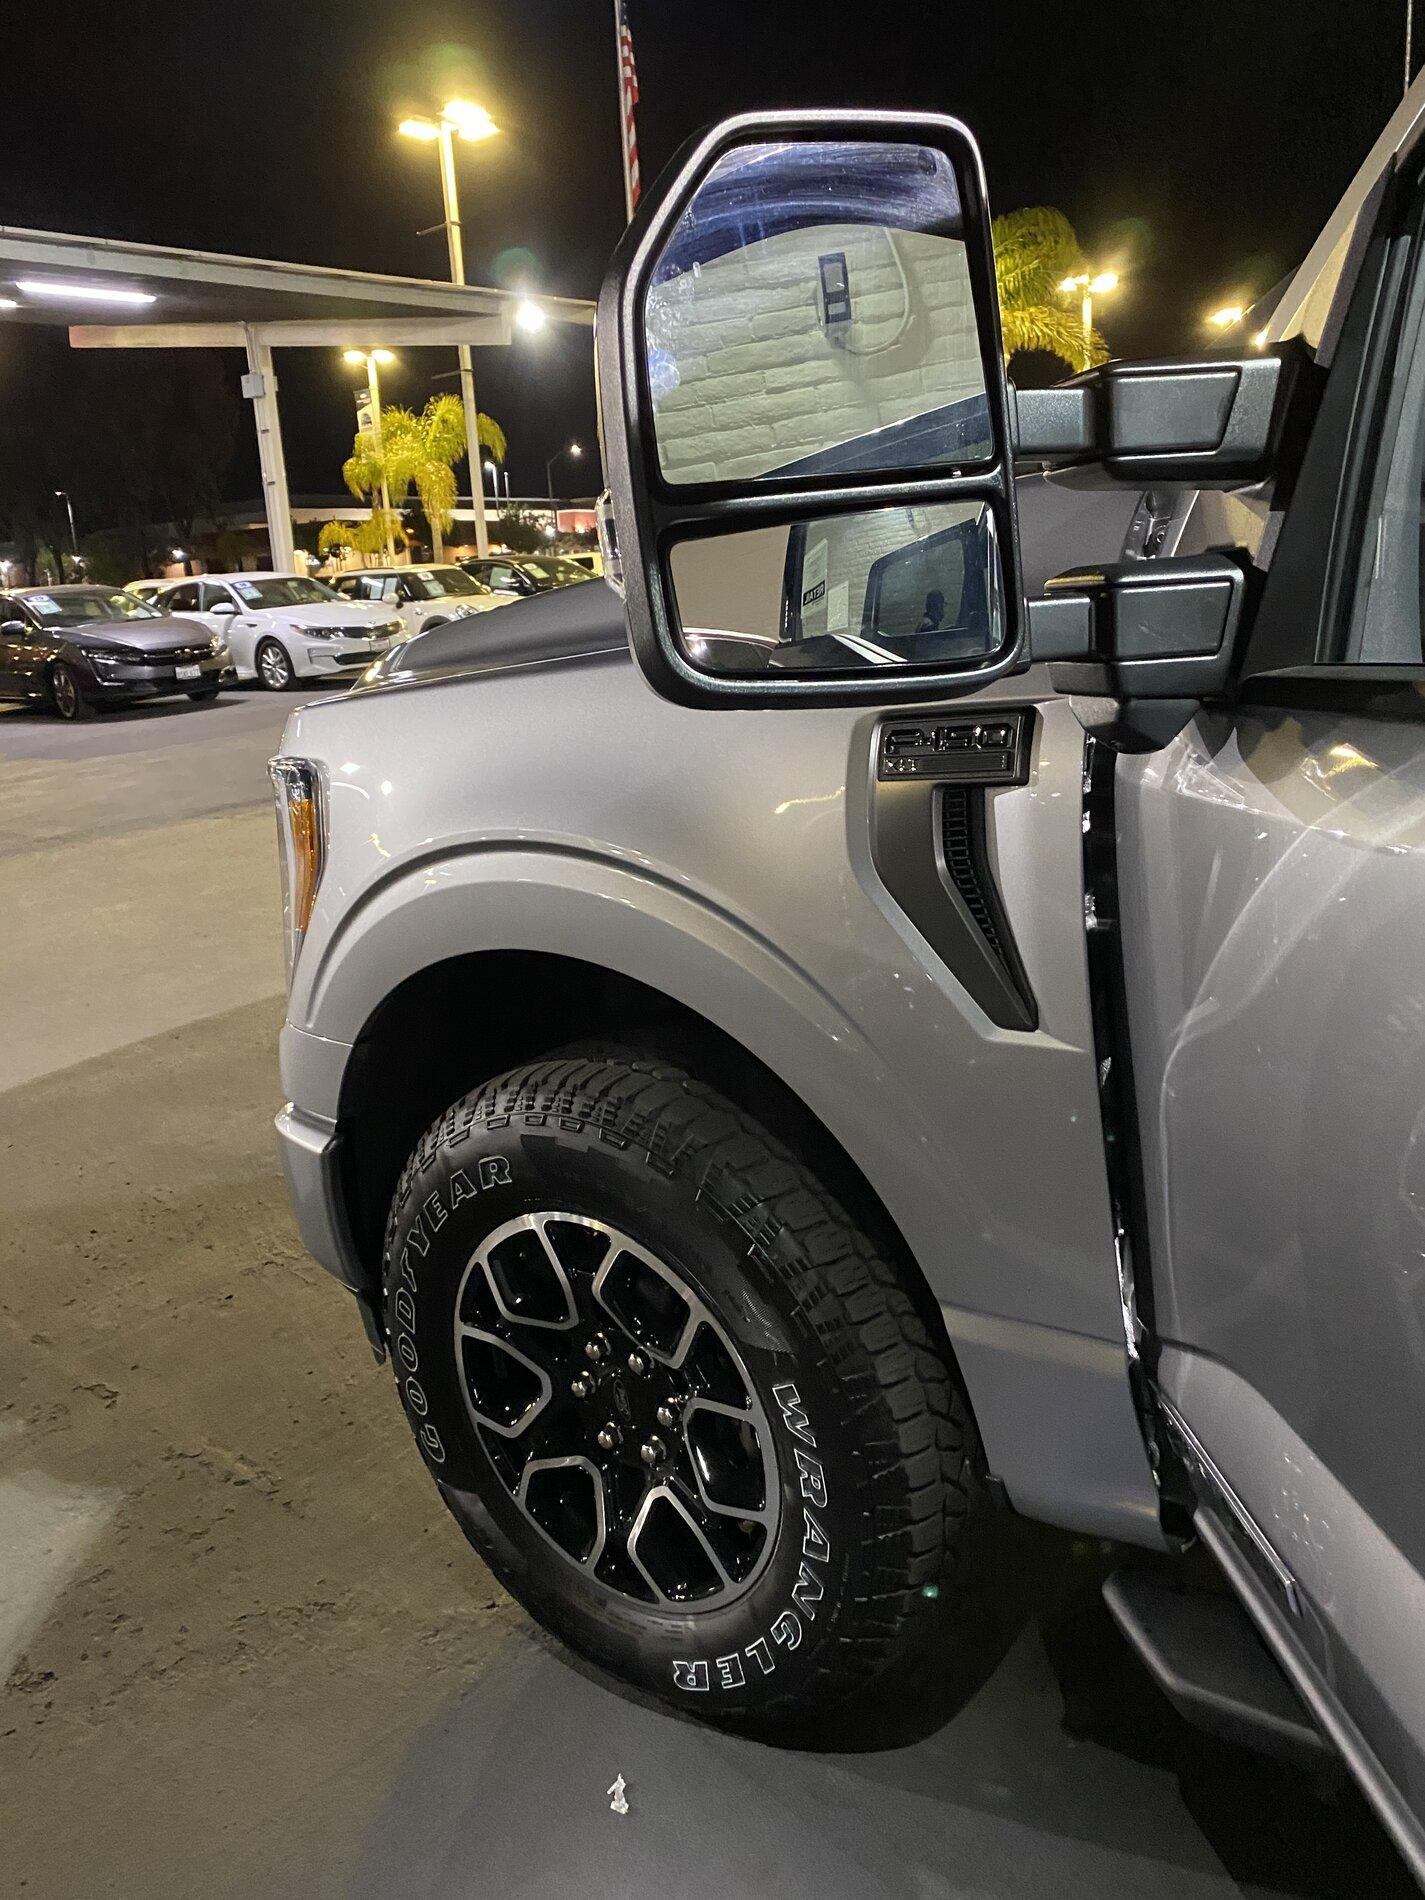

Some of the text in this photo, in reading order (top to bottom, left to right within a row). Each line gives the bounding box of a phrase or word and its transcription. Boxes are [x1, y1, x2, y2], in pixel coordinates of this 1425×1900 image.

[883, 723, 1015, 754] F-150
[395, 1155, 513, 1464] GOODYEAR
[672, 1383, 831, 1692] WRANGLER
